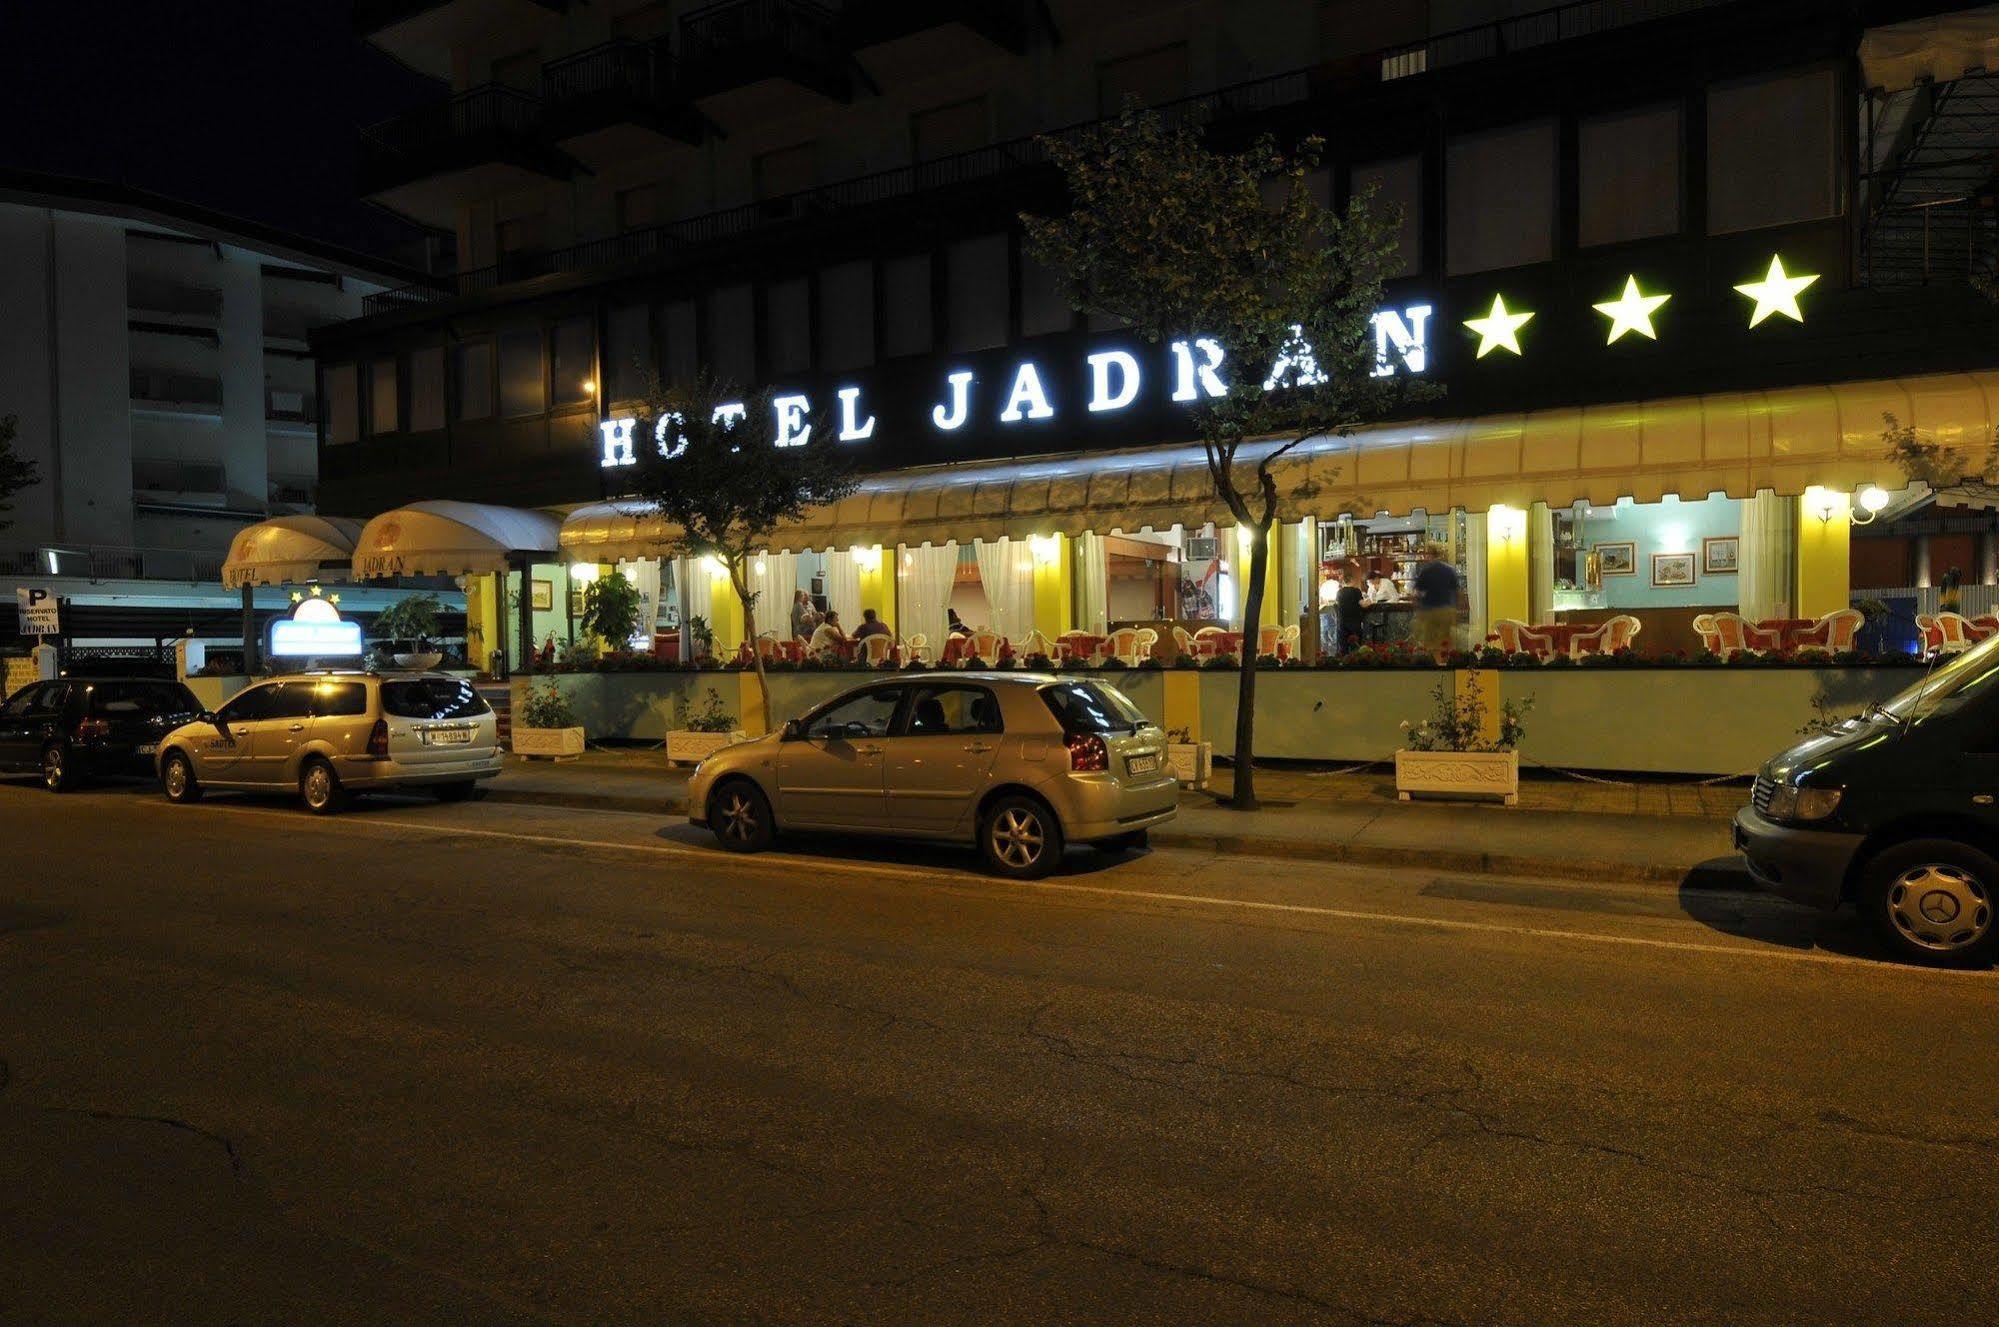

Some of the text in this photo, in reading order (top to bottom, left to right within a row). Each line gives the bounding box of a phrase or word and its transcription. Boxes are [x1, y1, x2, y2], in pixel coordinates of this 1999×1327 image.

[600, 304, 1433, 467] HOTEL JADRAN
[29, 589, 47, 606] P
